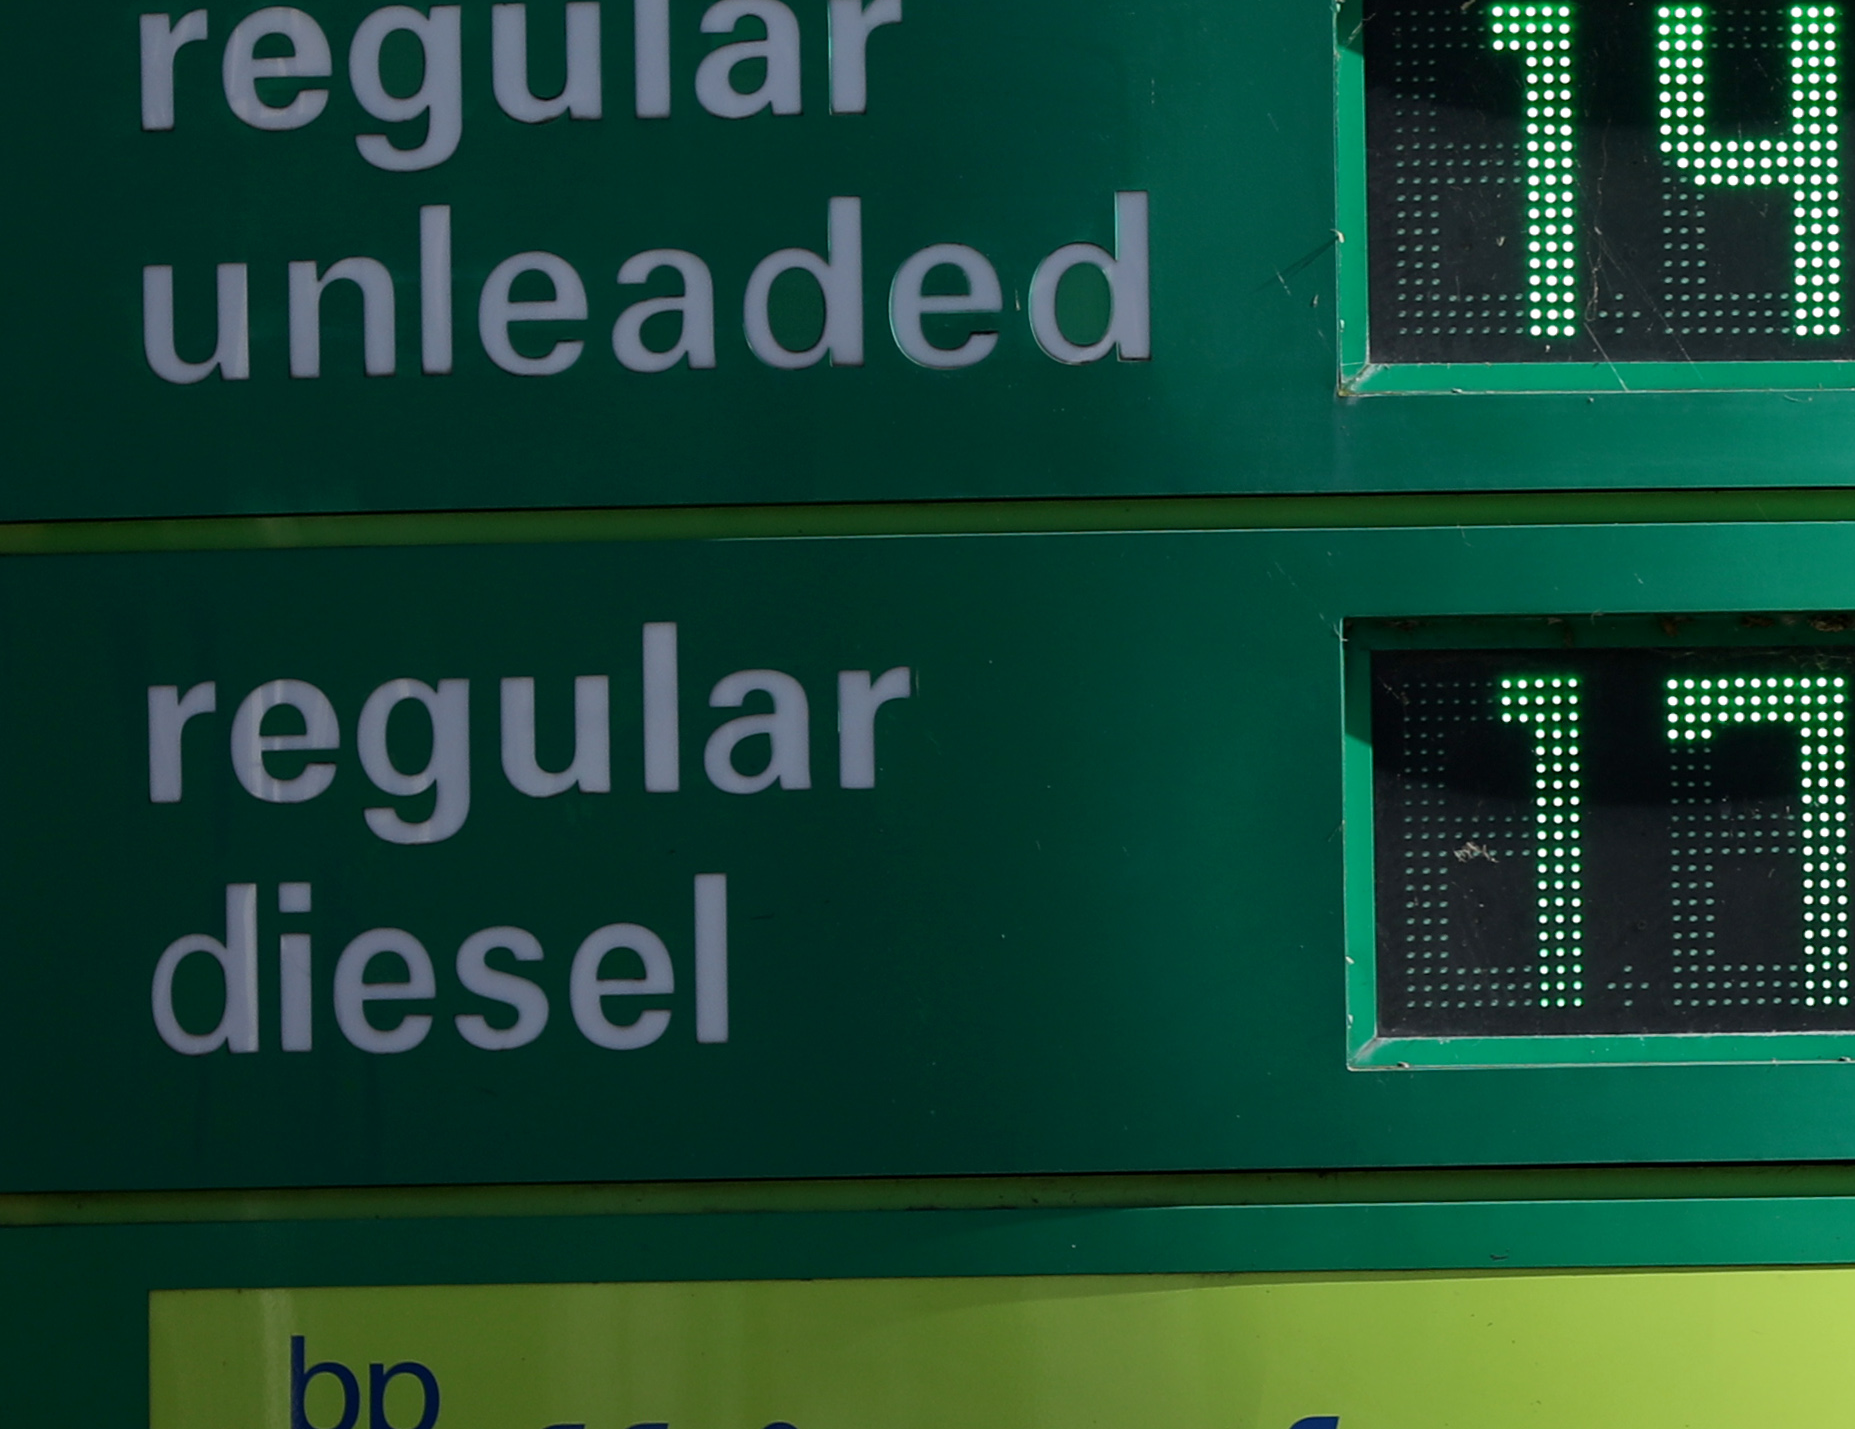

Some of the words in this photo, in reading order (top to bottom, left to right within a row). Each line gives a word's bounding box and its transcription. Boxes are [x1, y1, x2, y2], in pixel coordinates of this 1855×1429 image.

[141, 190, 1152, 384] unleaded
[146, 621, 912, 845] regular
[151, 873, 730, 1055] diesel
